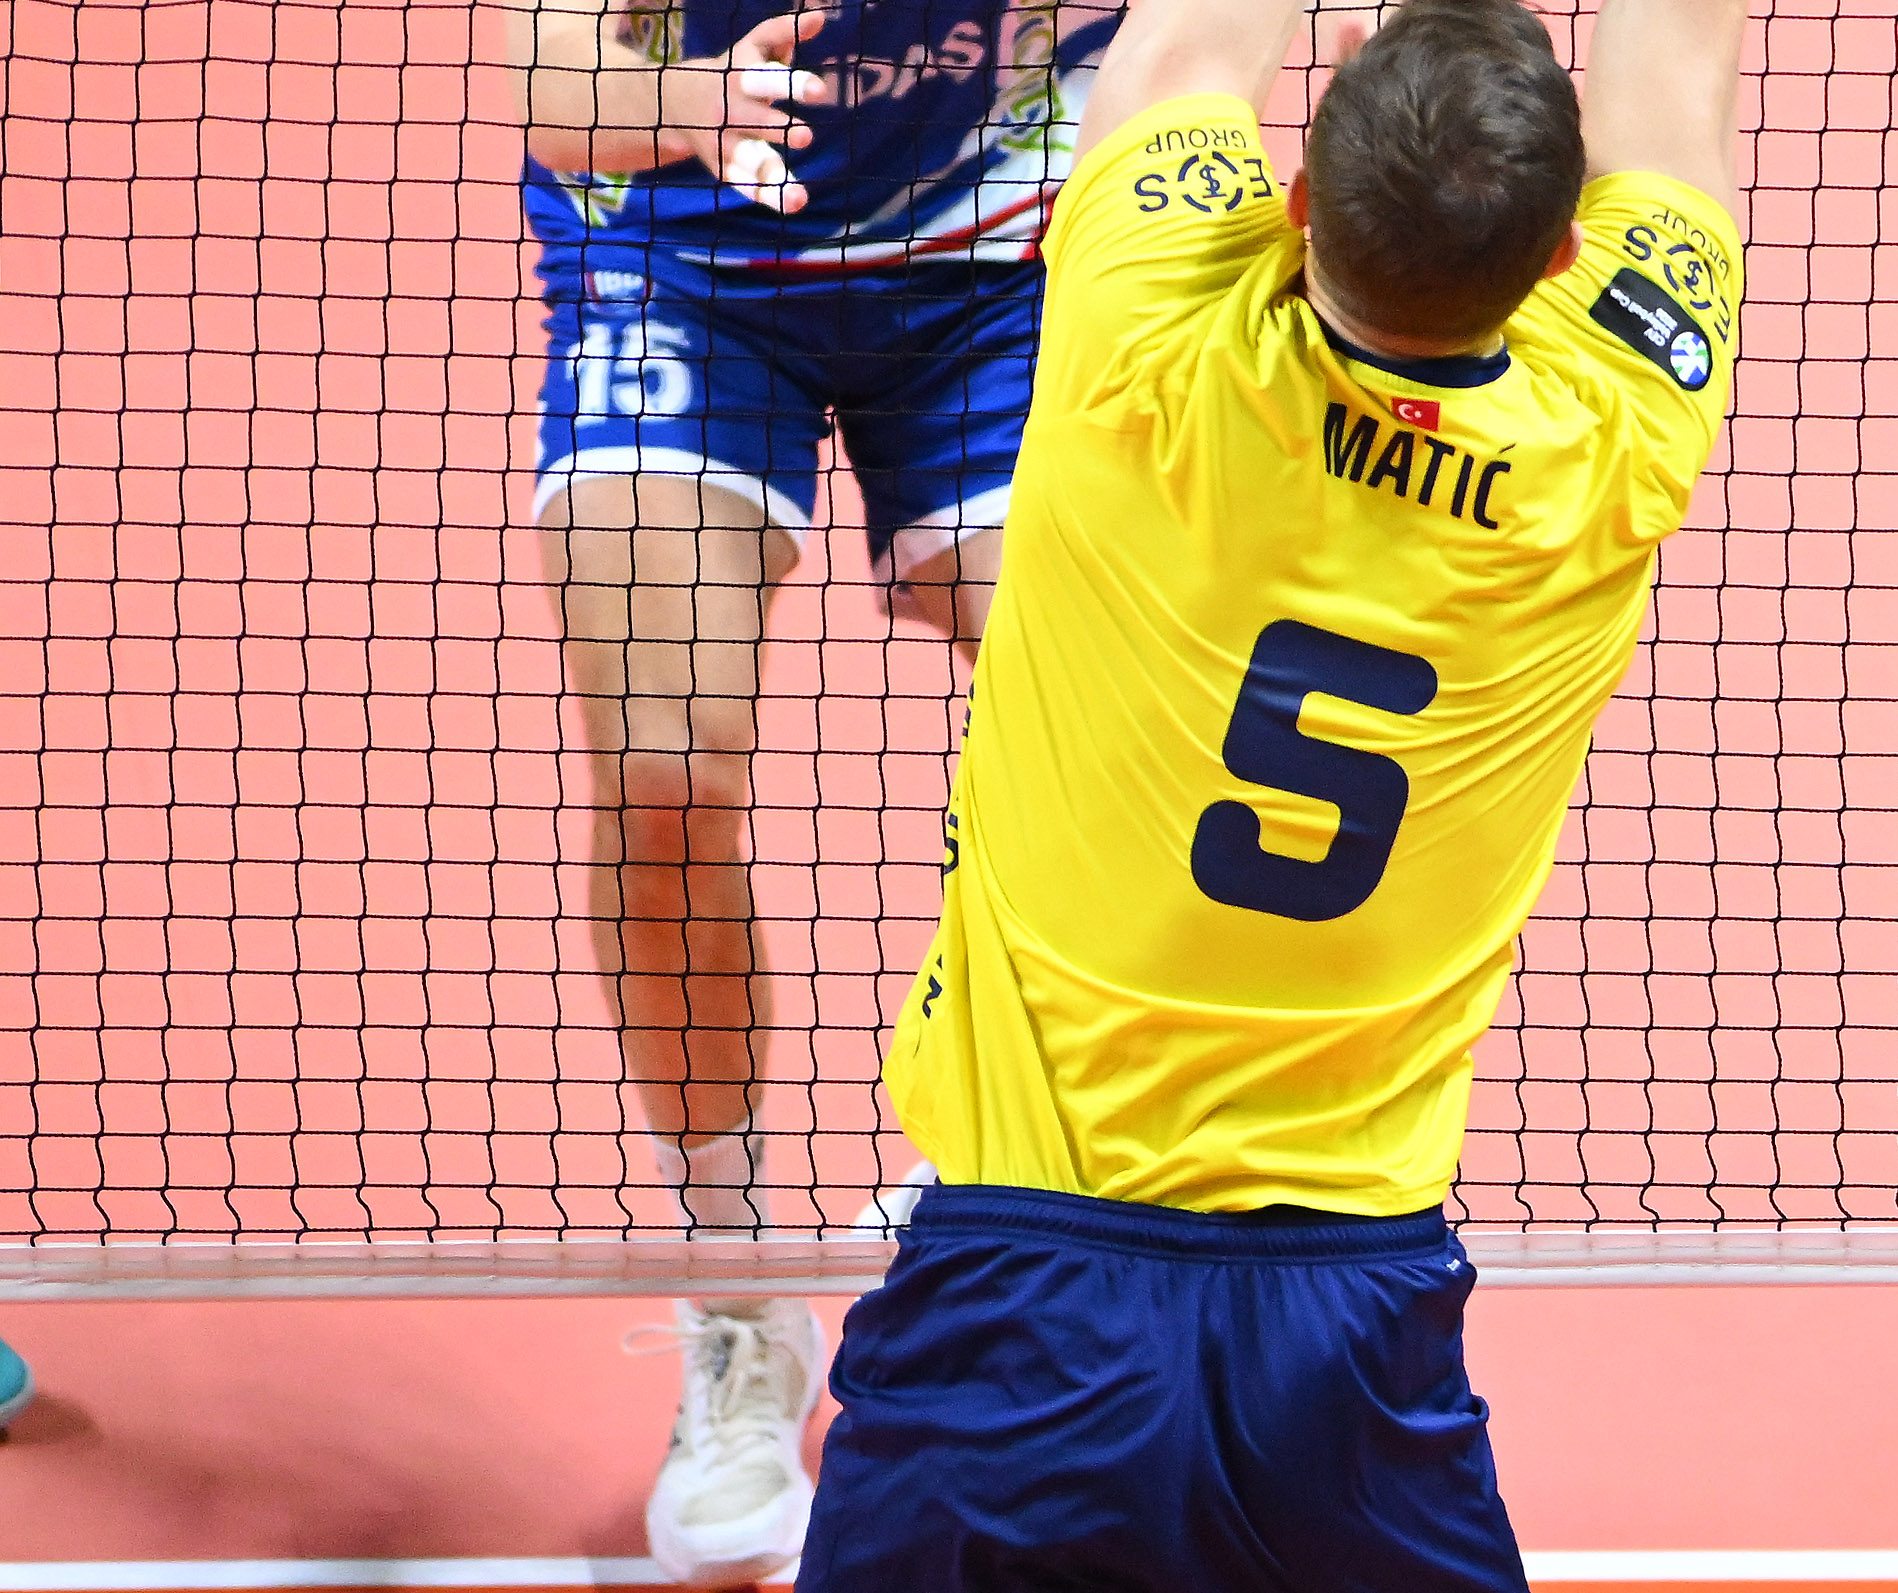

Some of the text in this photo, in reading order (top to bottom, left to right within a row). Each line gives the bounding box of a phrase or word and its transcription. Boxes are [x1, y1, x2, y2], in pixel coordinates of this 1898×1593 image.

[1145, 128, 1247, 155] GROUP
[565, 319, 694, 426] 15
[1322, 401, 1517, 530] MATIĆ
[1190, 618, 1439, 923] 5
